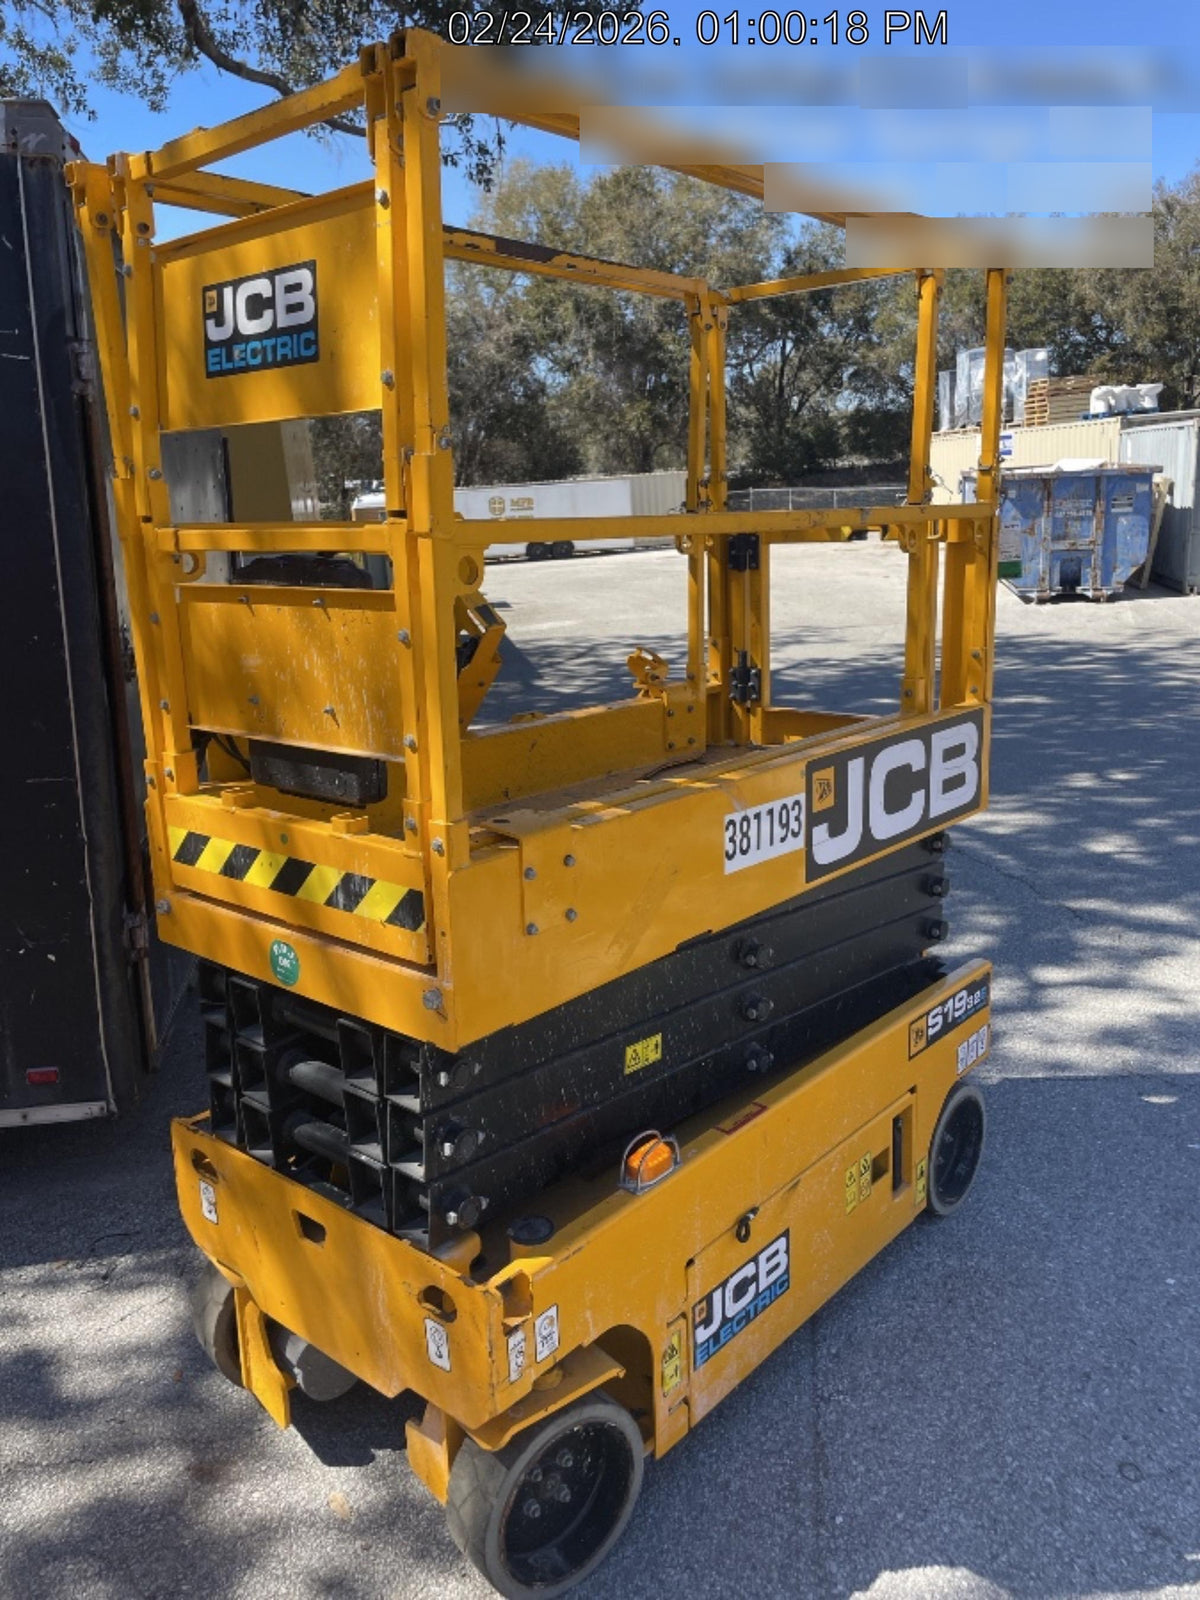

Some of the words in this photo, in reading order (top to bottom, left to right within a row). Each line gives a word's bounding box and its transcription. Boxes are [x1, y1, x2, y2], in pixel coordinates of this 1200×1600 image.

[205, 268, 316, 342] JCB
[207, 330, 317, 372] ELECTRIC
[724, 799, 803, 861] 381193
[812, 721, 979, 865] JCB
[695, 1236, 789, 1344] JCB
[696, 1274, 789, 1367] ELECTRIC
